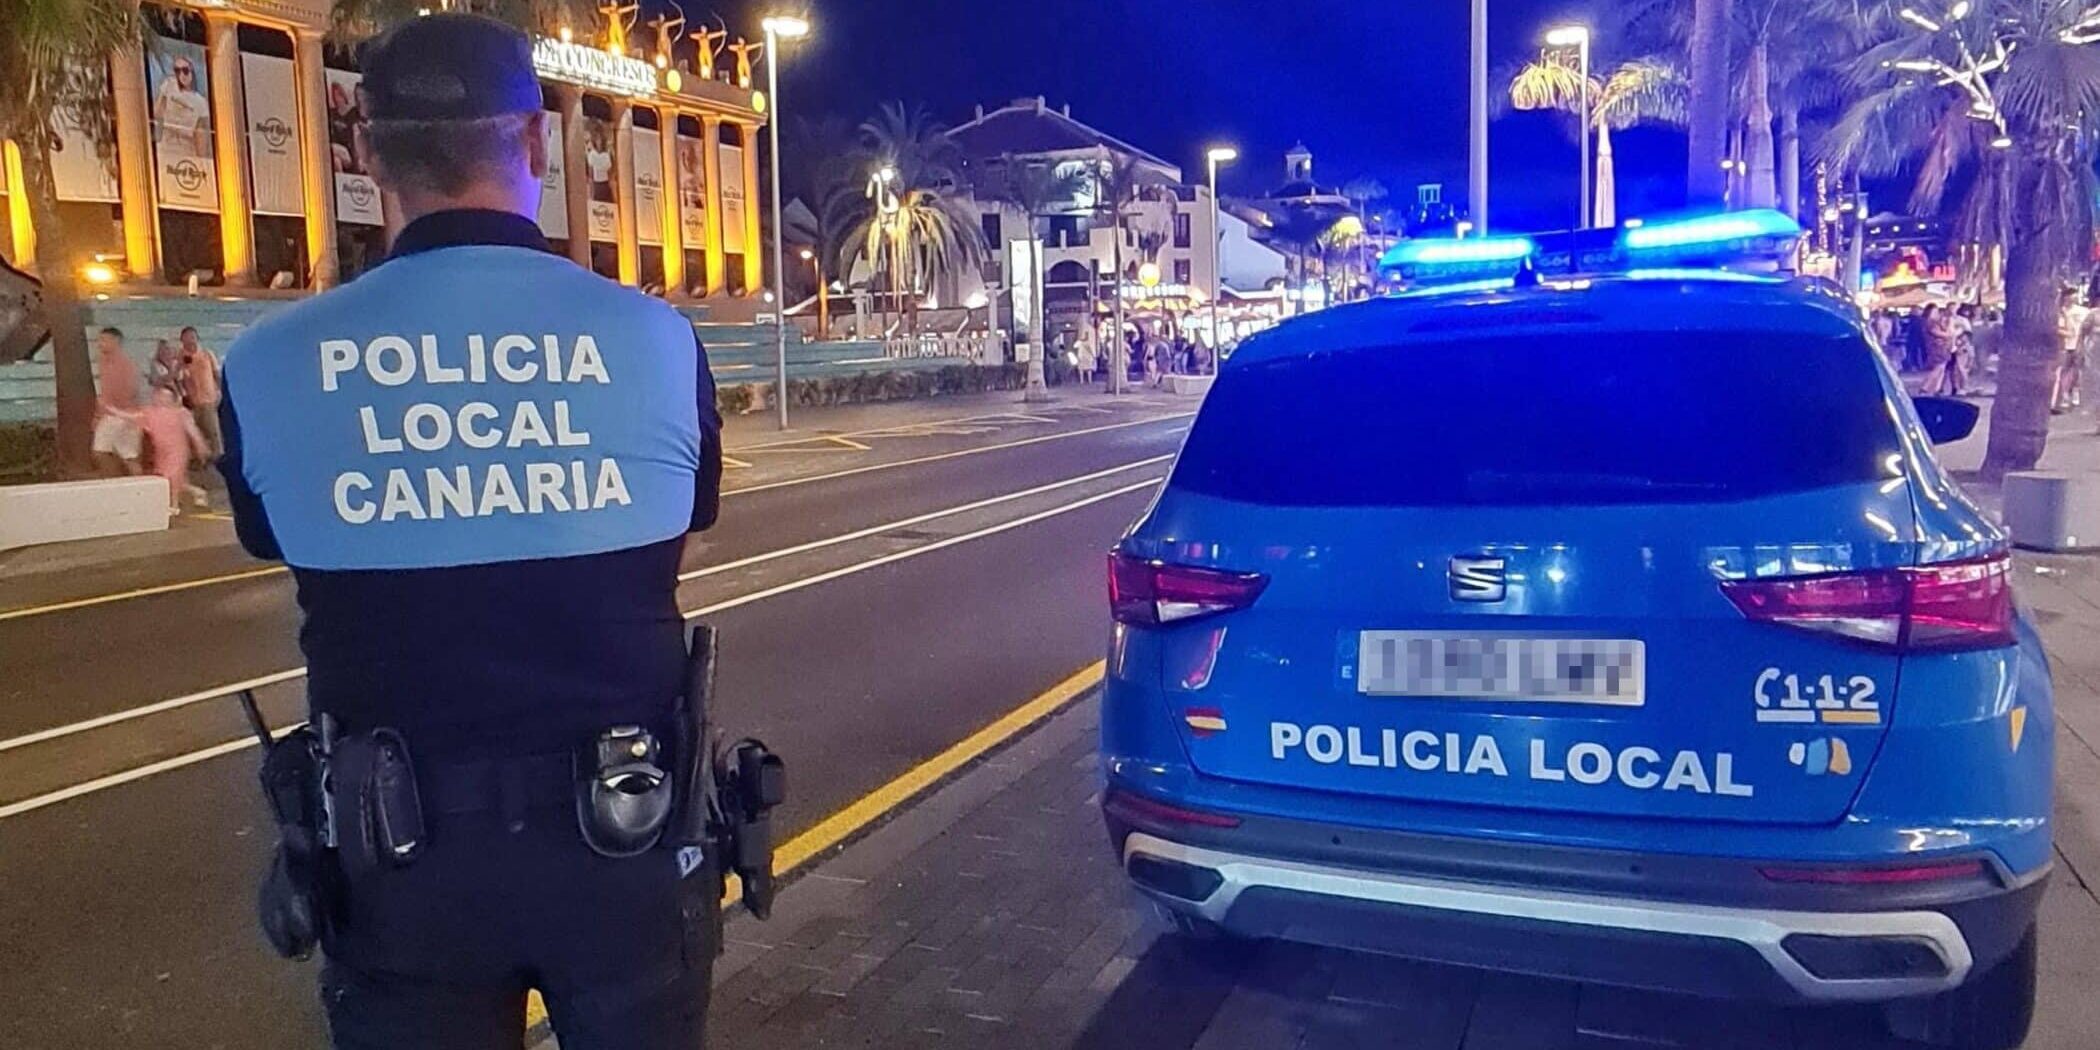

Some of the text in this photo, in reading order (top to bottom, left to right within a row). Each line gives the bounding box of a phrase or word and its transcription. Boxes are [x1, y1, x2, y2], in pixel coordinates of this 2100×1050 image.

[319, 334, 611, 392] POLICIA
[359, 400, 591, 454] LOCAL
[333, 457, 633, 525] CANARIA
[1270, 721, 1754, 797] POLICIA LOCAL
